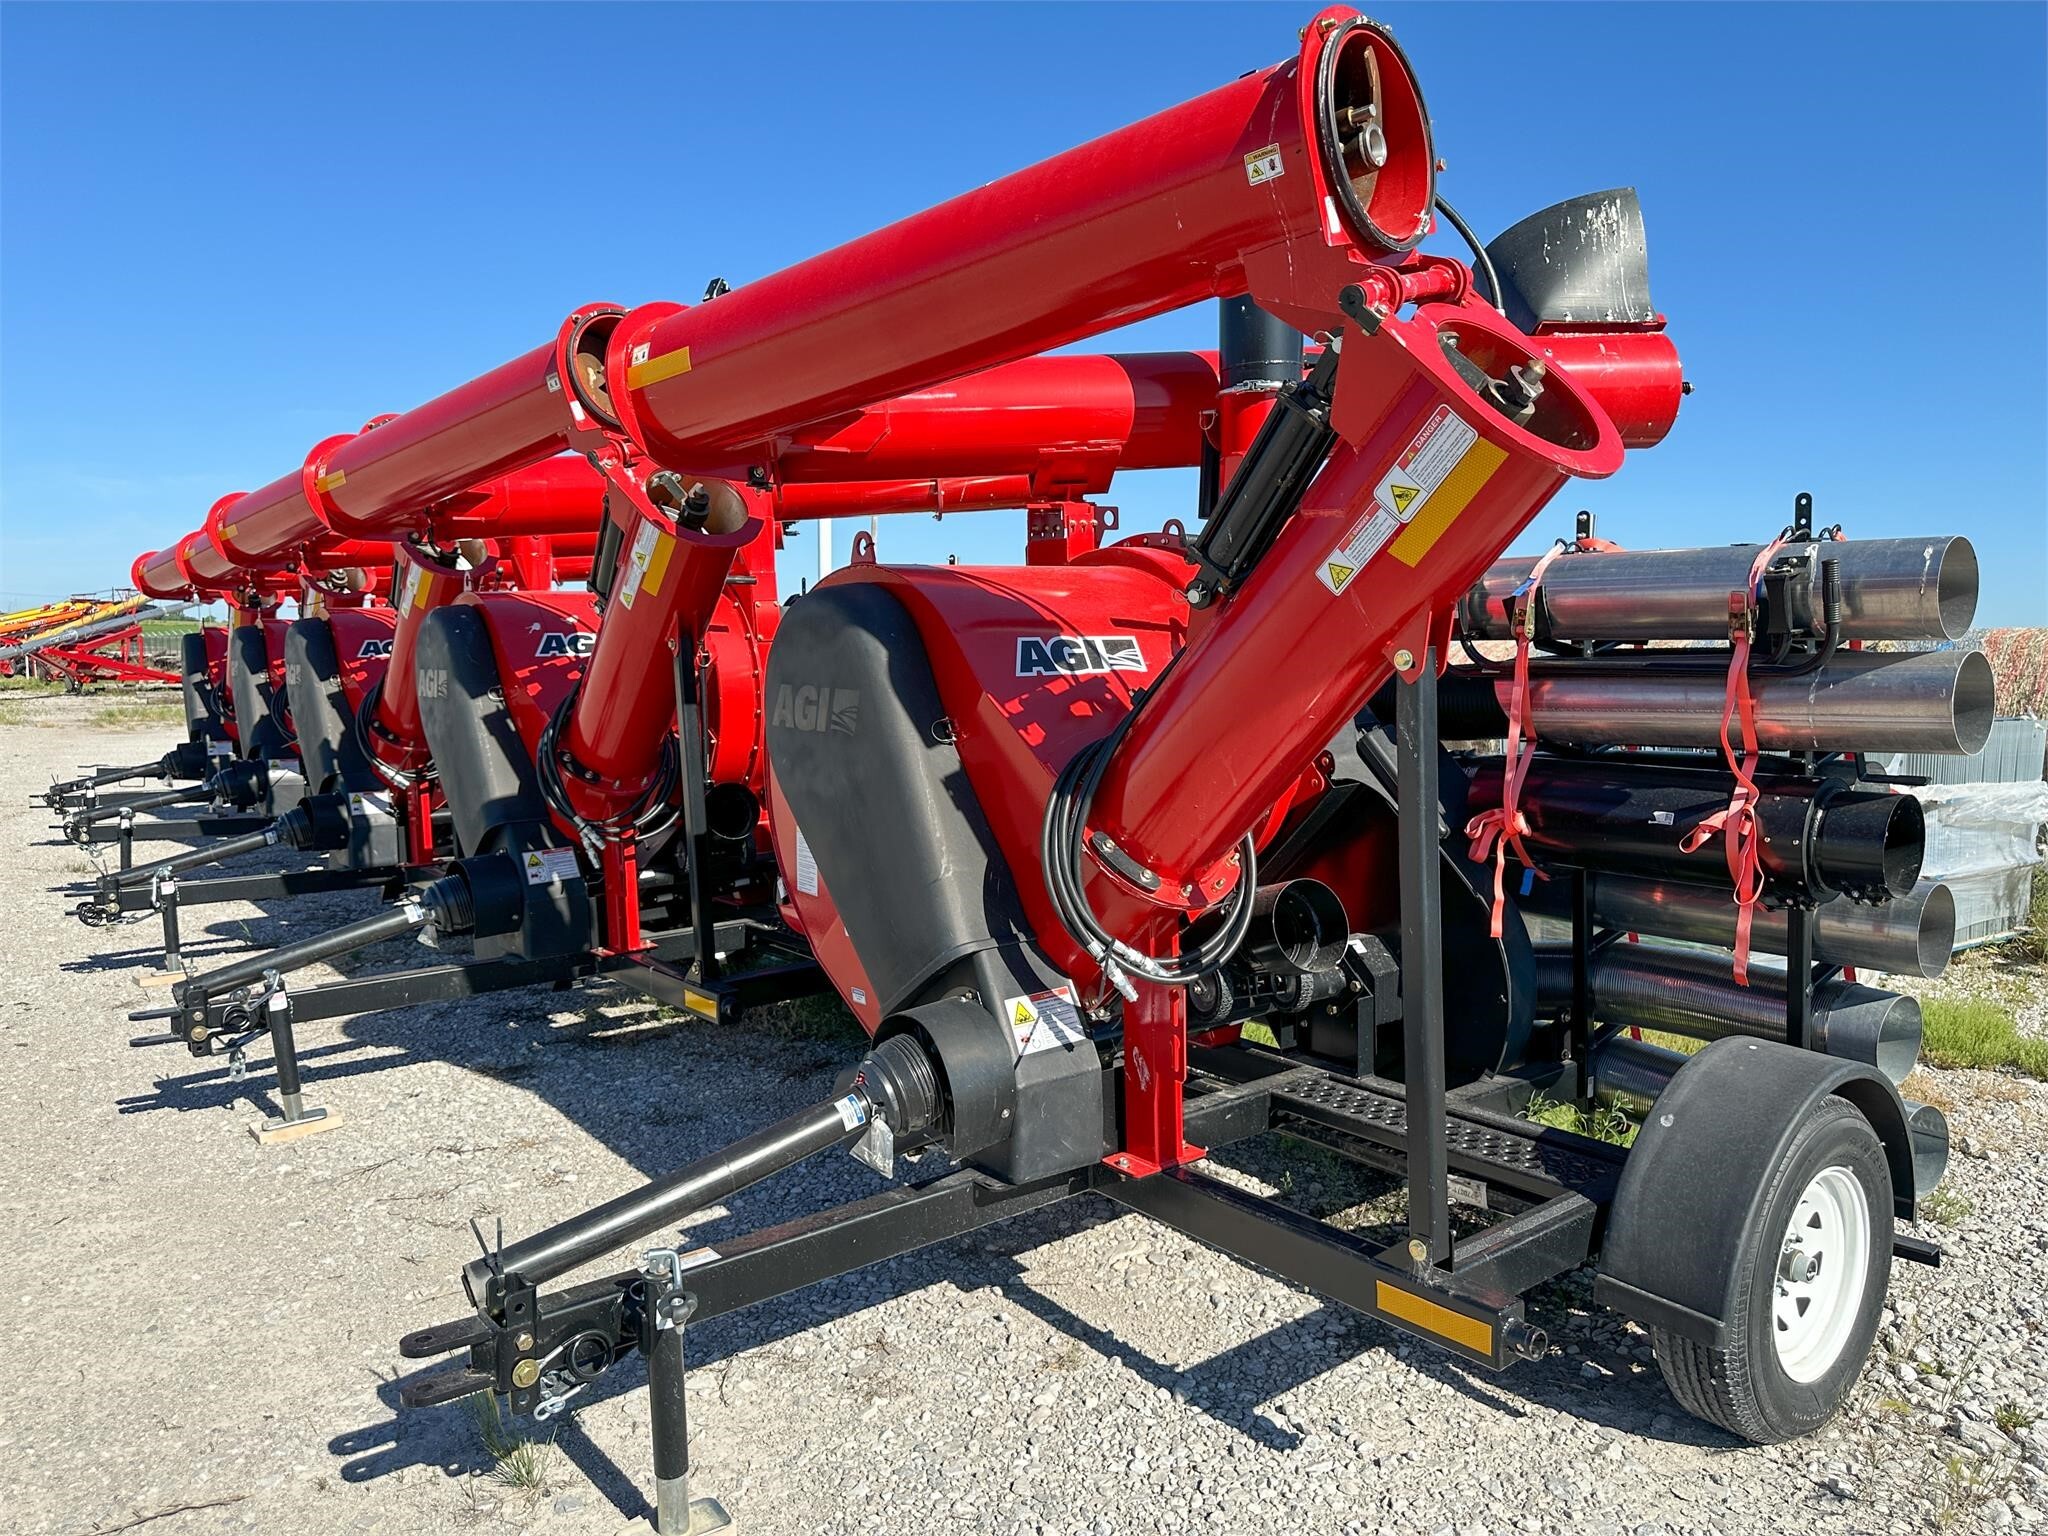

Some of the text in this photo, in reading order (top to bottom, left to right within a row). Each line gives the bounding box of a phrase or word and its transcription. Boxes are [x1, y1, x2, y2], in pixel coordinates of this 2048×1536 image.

[1414, 414, 1443, 449] DANGER
[538, 634, 596, 655] AG
[1019, 639, 1106, 673] AGI
[772, 684, 830, 733] AGI
